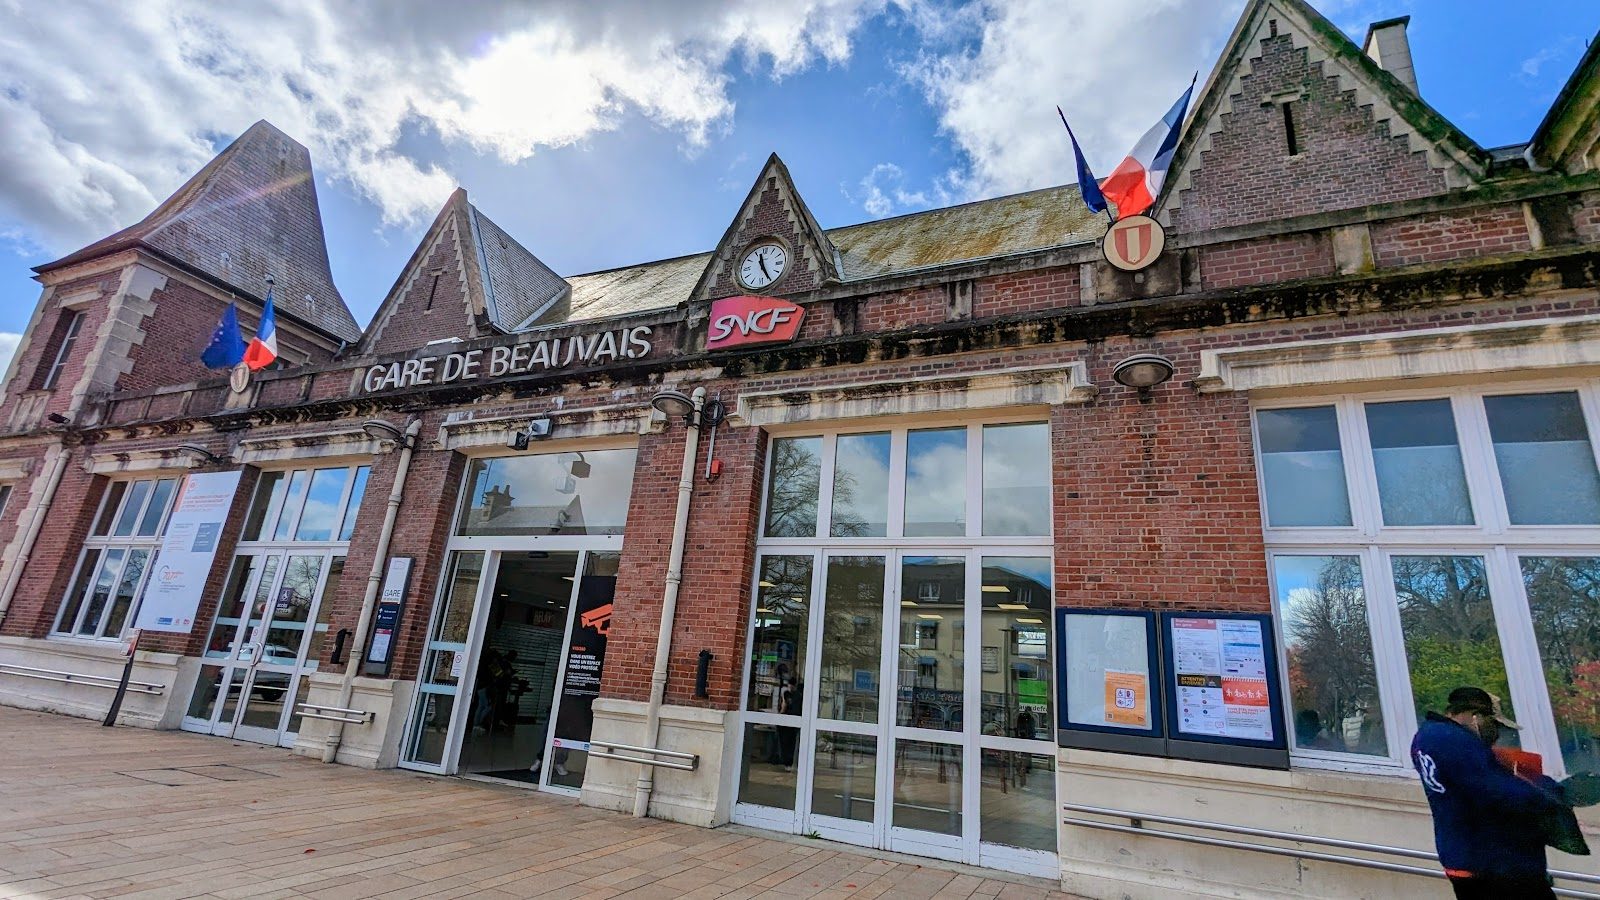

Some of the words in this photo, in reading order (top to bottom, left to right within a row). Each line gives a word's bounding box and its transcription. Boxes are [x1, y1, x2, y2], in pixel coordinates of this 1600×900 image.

[709, 306, 797, 342] SNCF
[364, 356, 437, 393] GARE
[442, 349, 483, 383] DE
[490, 325, 652, 377] BEAUVAIS
[384, 589, 401, 598] GARE
